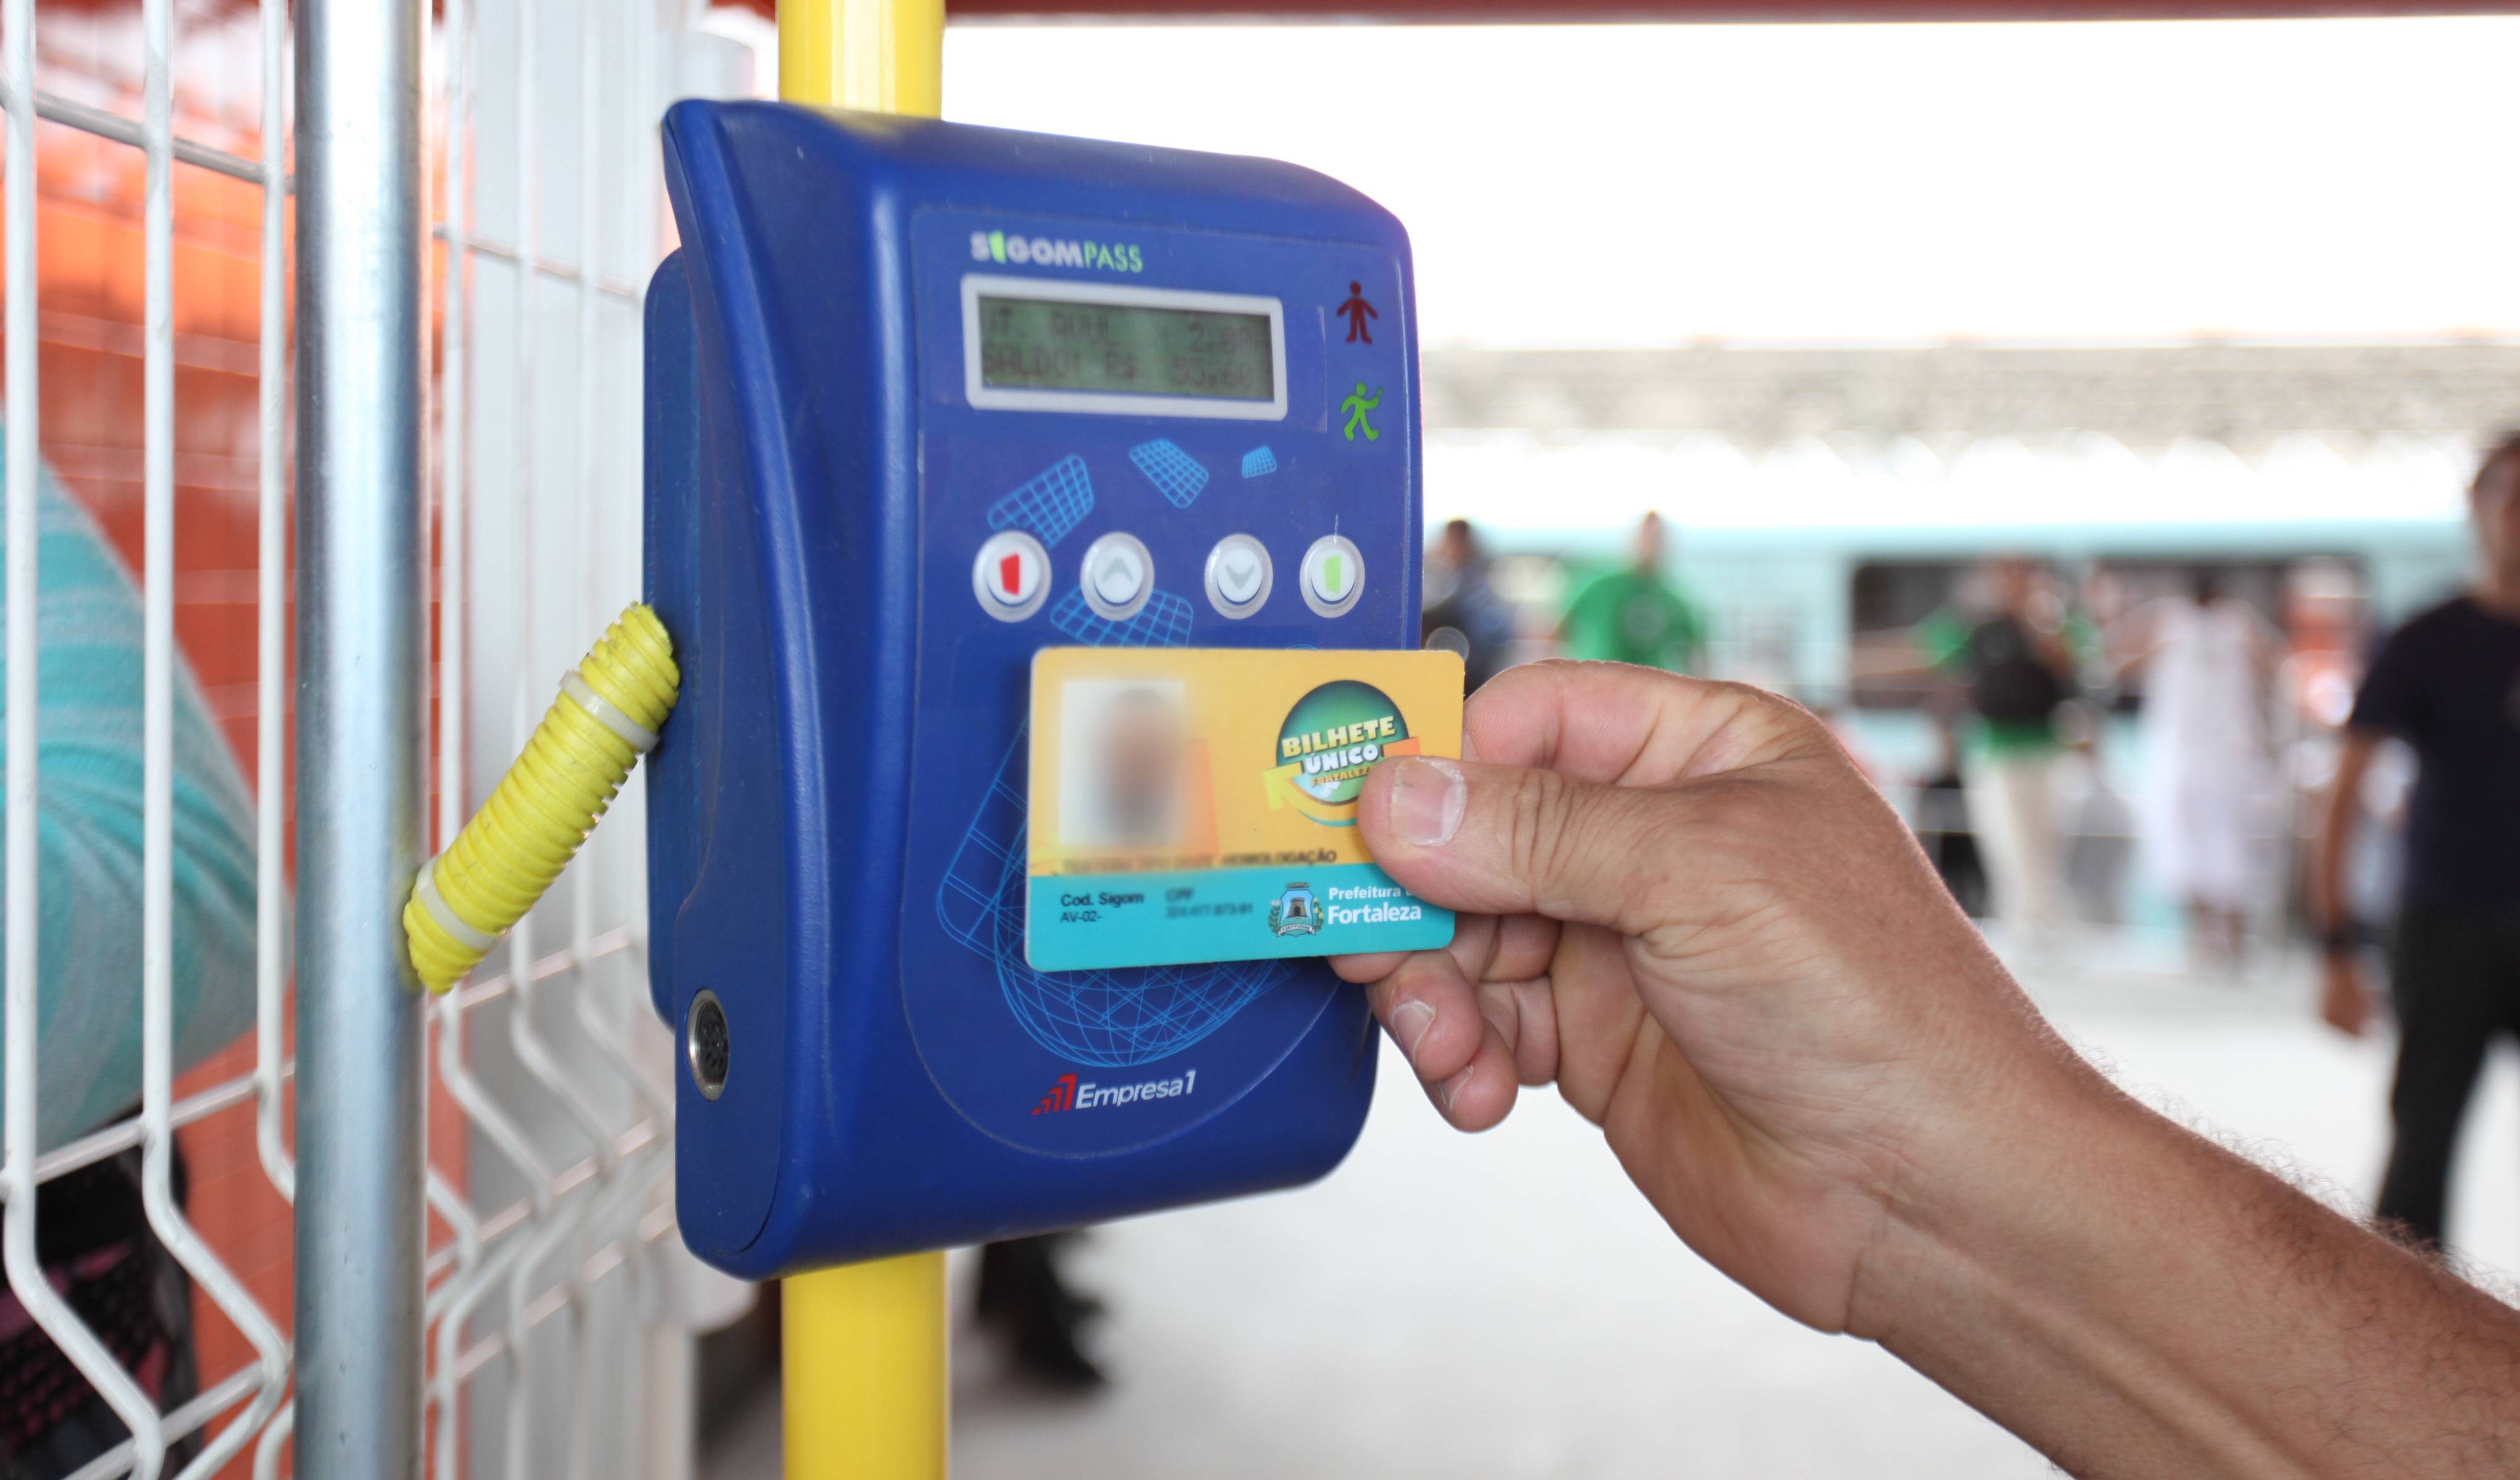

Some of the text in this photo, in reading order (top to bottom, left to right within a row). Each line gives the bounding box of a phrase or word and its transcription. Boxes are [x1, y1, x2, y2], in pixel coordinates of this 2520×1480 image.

[1282, 716, 1396, 758] BILHETE
[1305, 743, 1379, 774] ÚNICO
[1060, 892, 1144, 909] Cod. Sigom
[1329, 885, 1401, 900] Prefeitura
[1328, 901, 1422, 925] Fortaleza
[1075, 1068, 1196, 1110] Empresa1
